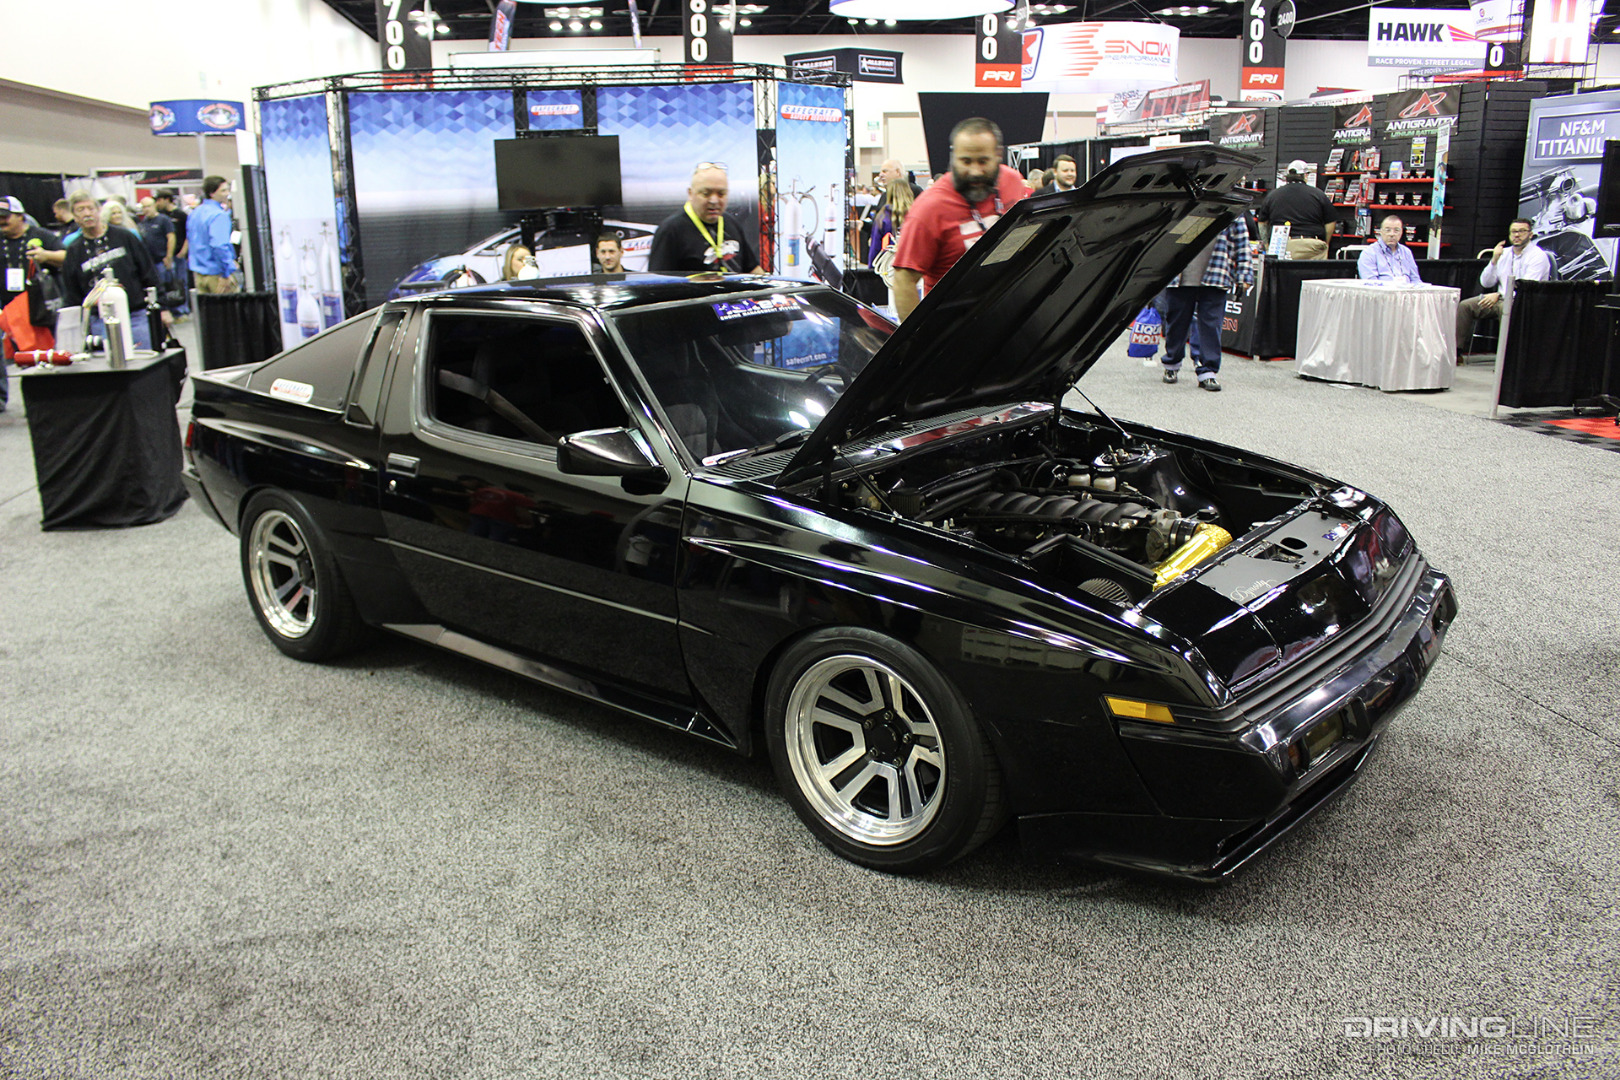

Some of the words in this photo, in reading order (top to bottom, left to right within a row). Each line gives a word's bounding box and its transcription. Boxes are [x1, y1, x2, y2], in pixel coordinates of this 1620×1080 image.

[1277, 11, 1294, 26] 2400
[1377, 22, 1445, 42] HAWK
[1105, 40, 1171, 57] SNOW
[1395, 58, 1424, 66] PROVEN.
[982, 70, 1015, 81] PRI
[1249, 73, 1278, 84] PRI
[785, 106, 835, 116] SAFECRAFT
[1387, 117, 1458, 132] ANTIGRAVITY
[1560, 119, 1606, 137] NF&M
[1219, 133, 1264, 145] ANTIGRAVITY
[1538, 136, 1617, 156] TITANIU
